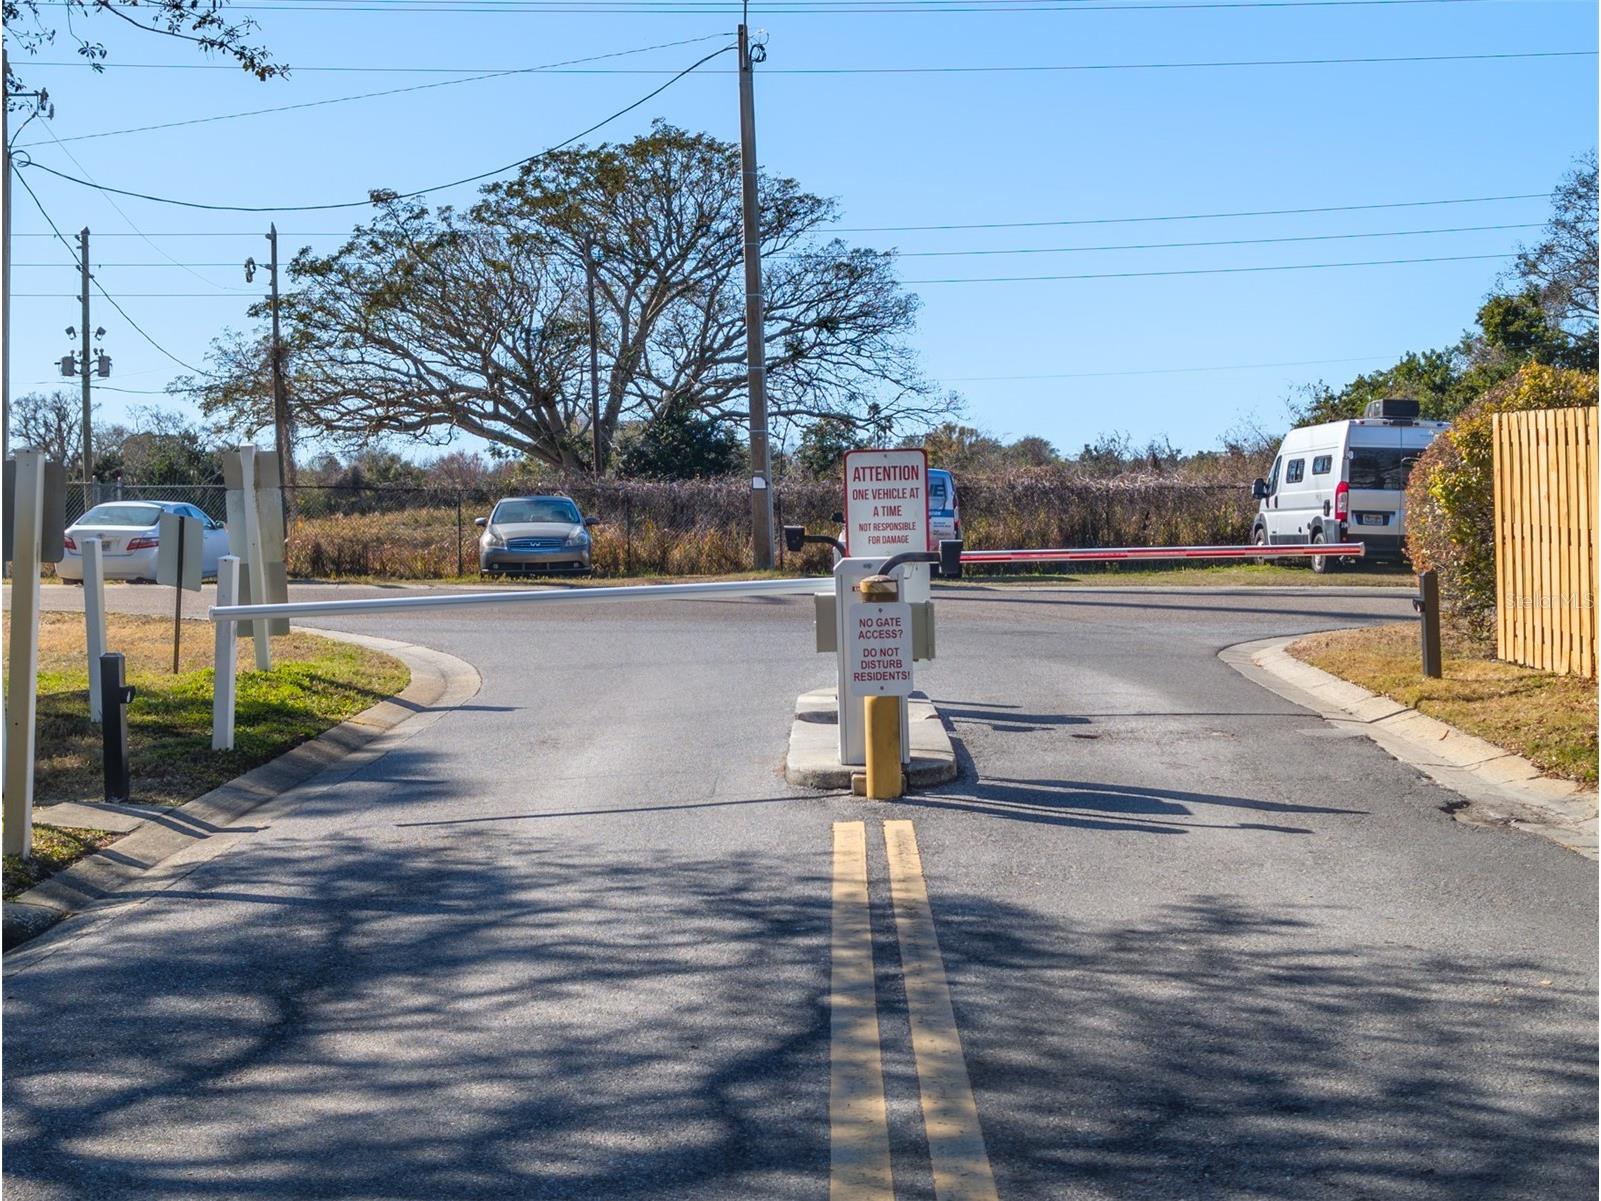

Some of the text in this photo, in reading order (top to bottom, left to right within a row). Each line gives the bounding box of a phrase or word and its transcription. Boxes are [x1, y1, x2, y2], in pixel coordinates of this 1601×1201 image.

[853, 465, 919, 482] ATTENTION
[852, 487, 920, 501] ONE VEHICLE AT
[873, 505, 902, 517] A TIME
[859, 521, 916, 532] NOT RESPONSIBLE
[868, 534, 909, 545] FOR DAMAGE
[859, 617, 902, 628] NO GATE
[858, 629, 904, 640] ACCESS?
[863, 647, 900, 658] DO NOT
[861, 659, 903, 670] DISTURB
[853, 670, 911, 681] RESIDENTS!
